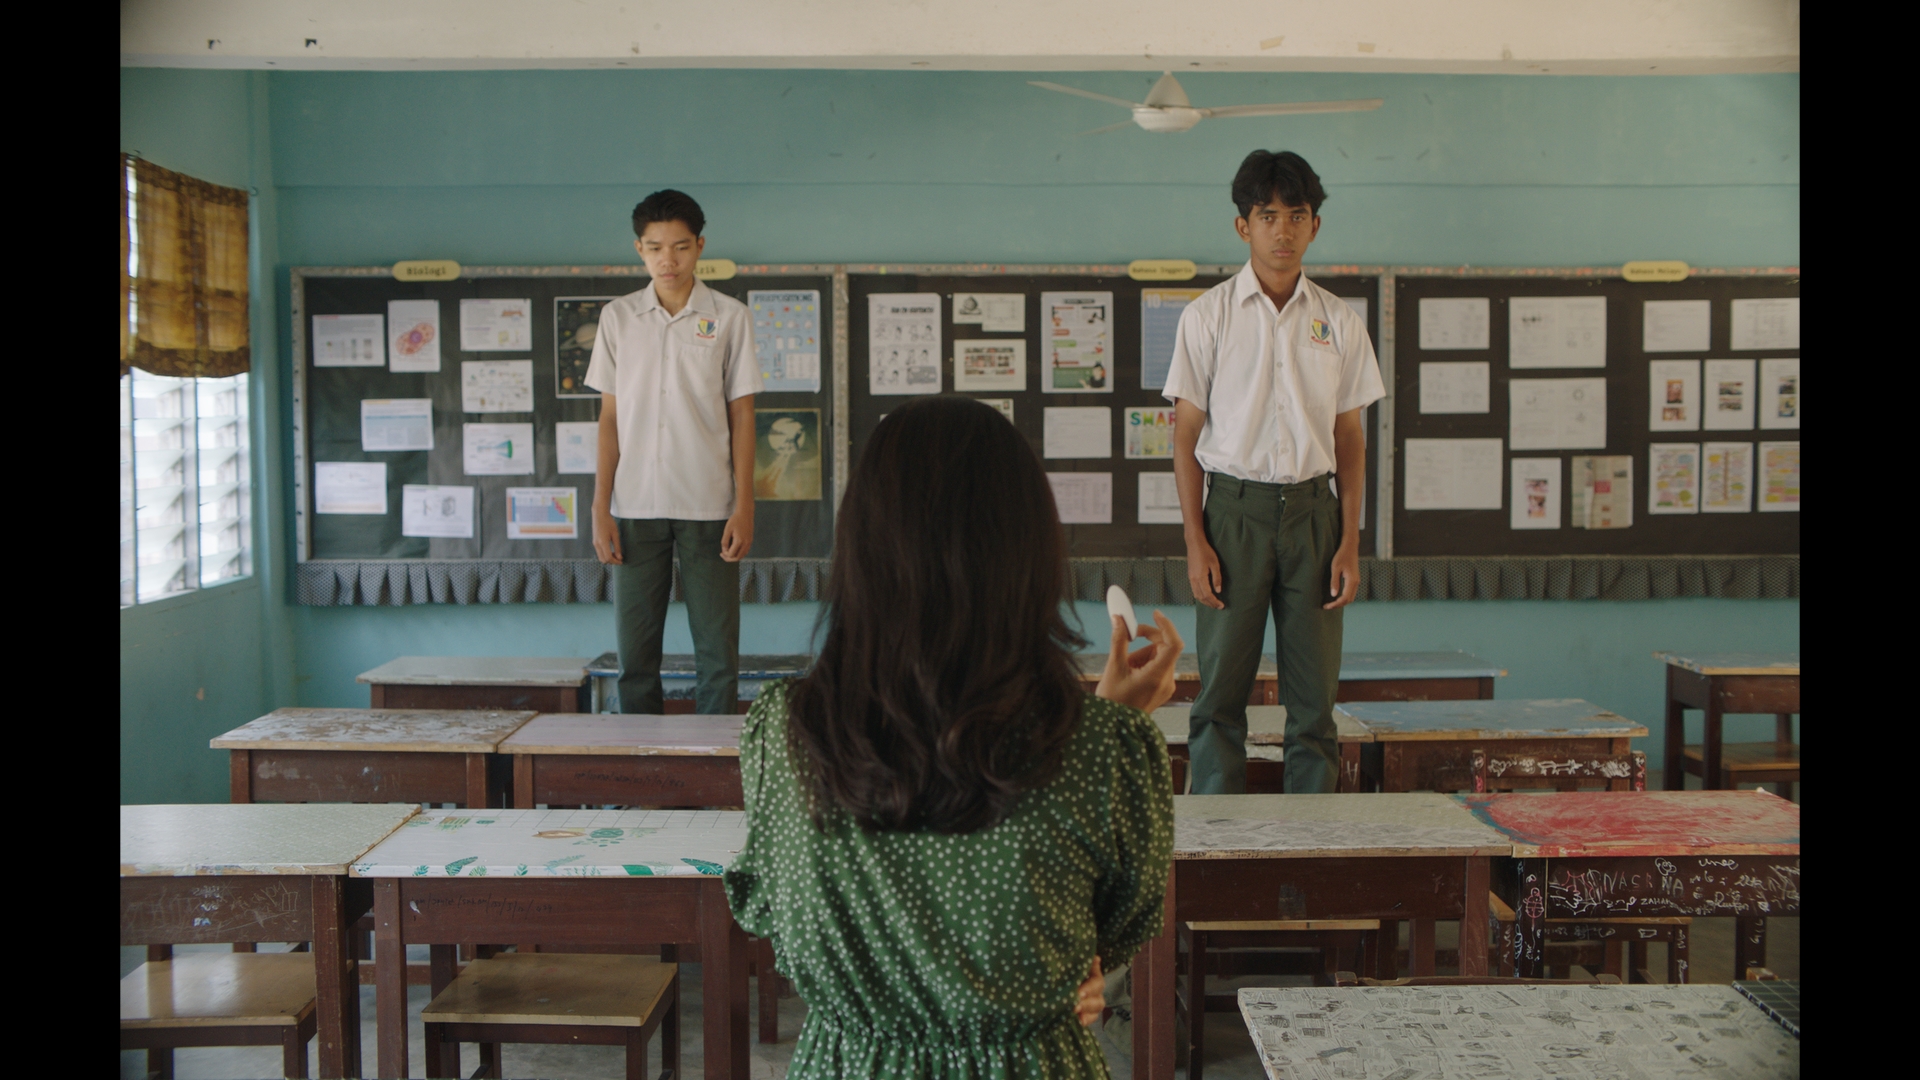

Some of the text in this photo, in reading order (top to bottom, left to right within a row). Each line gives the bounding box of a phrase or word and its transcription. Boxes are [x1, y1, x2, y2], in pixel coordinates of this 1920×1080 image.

[406, 265, 446, 277] Biologi
[694, 265, 716, 275] izik
[1146, 294, 1161, 309] 10
[1130, 411, 1176, 427] SMAR
